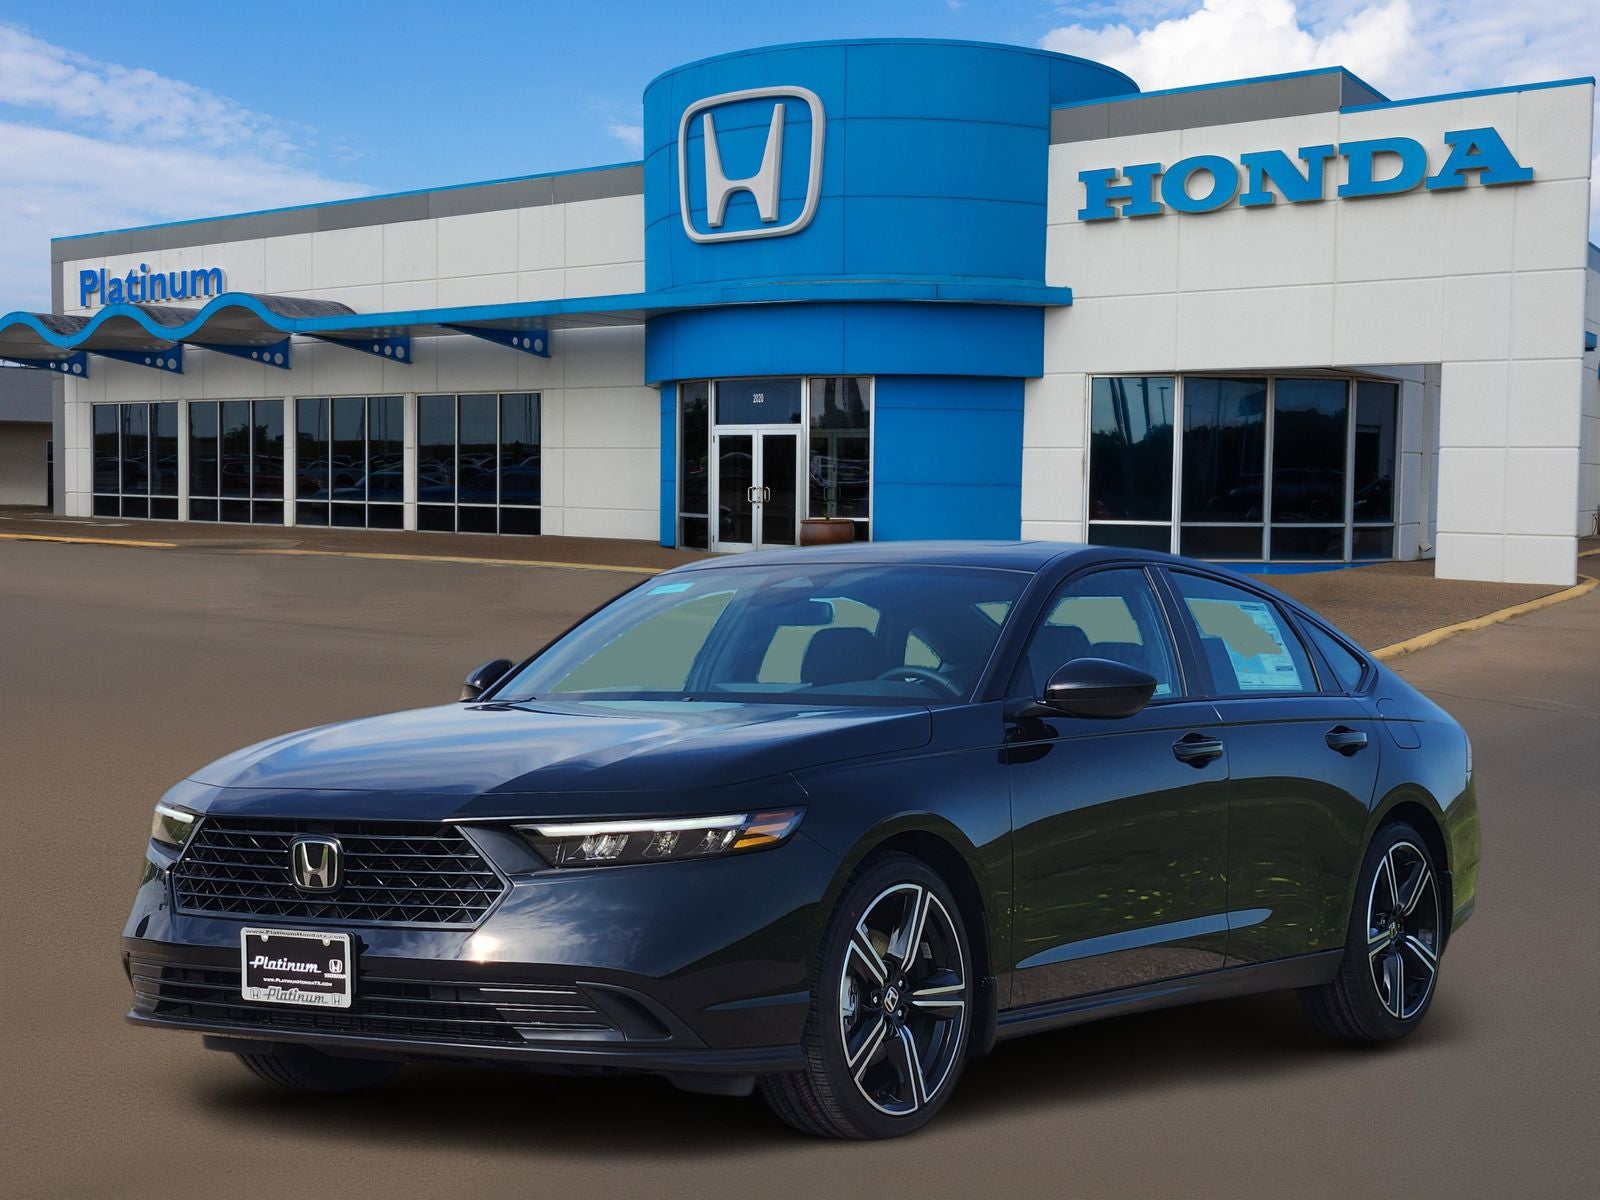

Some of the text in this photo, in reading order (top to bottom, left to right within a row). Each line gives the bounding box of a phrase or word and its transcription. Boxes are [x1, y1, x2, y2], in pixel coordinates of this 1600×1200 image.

[1078, 127, 1534, 222] HONDA
[80, 263, 224, 307] Platinum
[249, 955, 322, 974] Platinum
[263, 987, 329, 1004] Platinum
